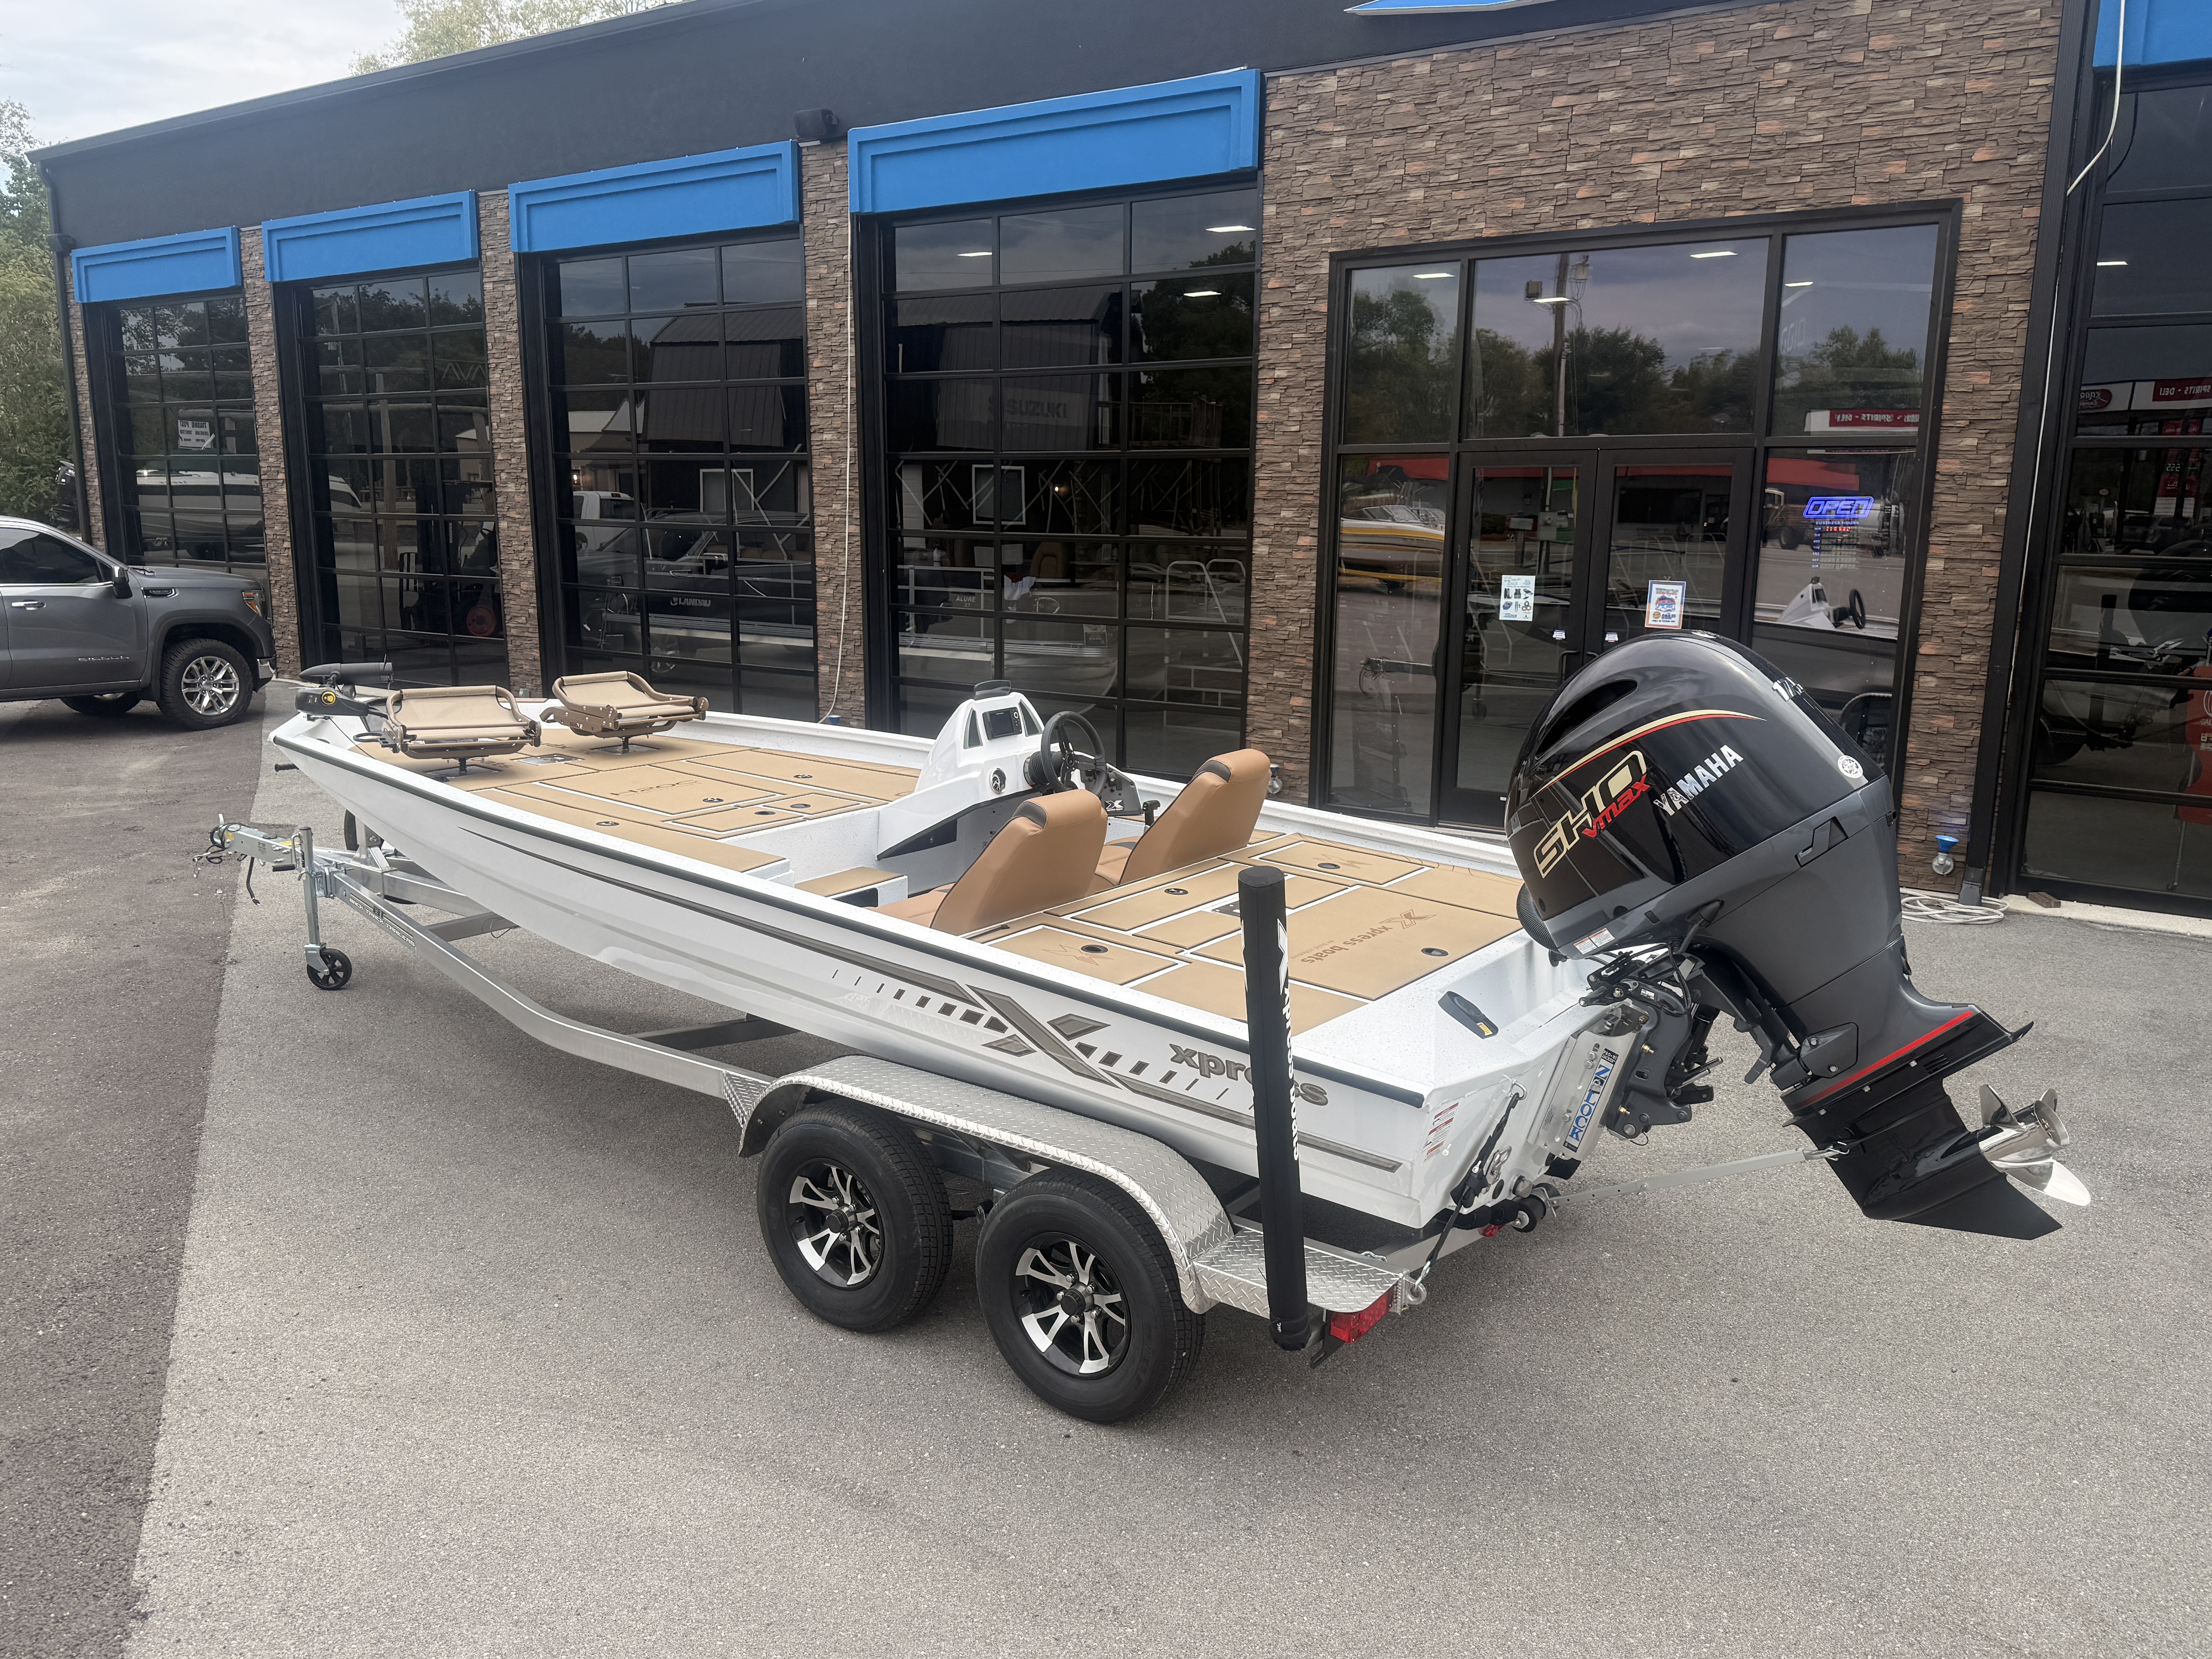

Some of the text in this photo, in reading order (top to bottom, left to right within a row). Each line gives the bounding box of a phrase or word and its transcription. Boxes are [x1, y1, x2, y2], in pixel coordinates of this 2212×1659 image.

[1006, 398, 1068, 419] SUZUKI
[1807, 500, 1869, 515] OPEN
[678, 598, 711, 607] LANDAU
[1653, 744, 1744, 816] YAMAHA
[1533, 750, 1647, 878] SHO
[349, 898, 416, 947] BACK TRACK TRAILERS
[373, 905, 386, 919] BT
[1301, 925, 1393, 963] xpress boats
